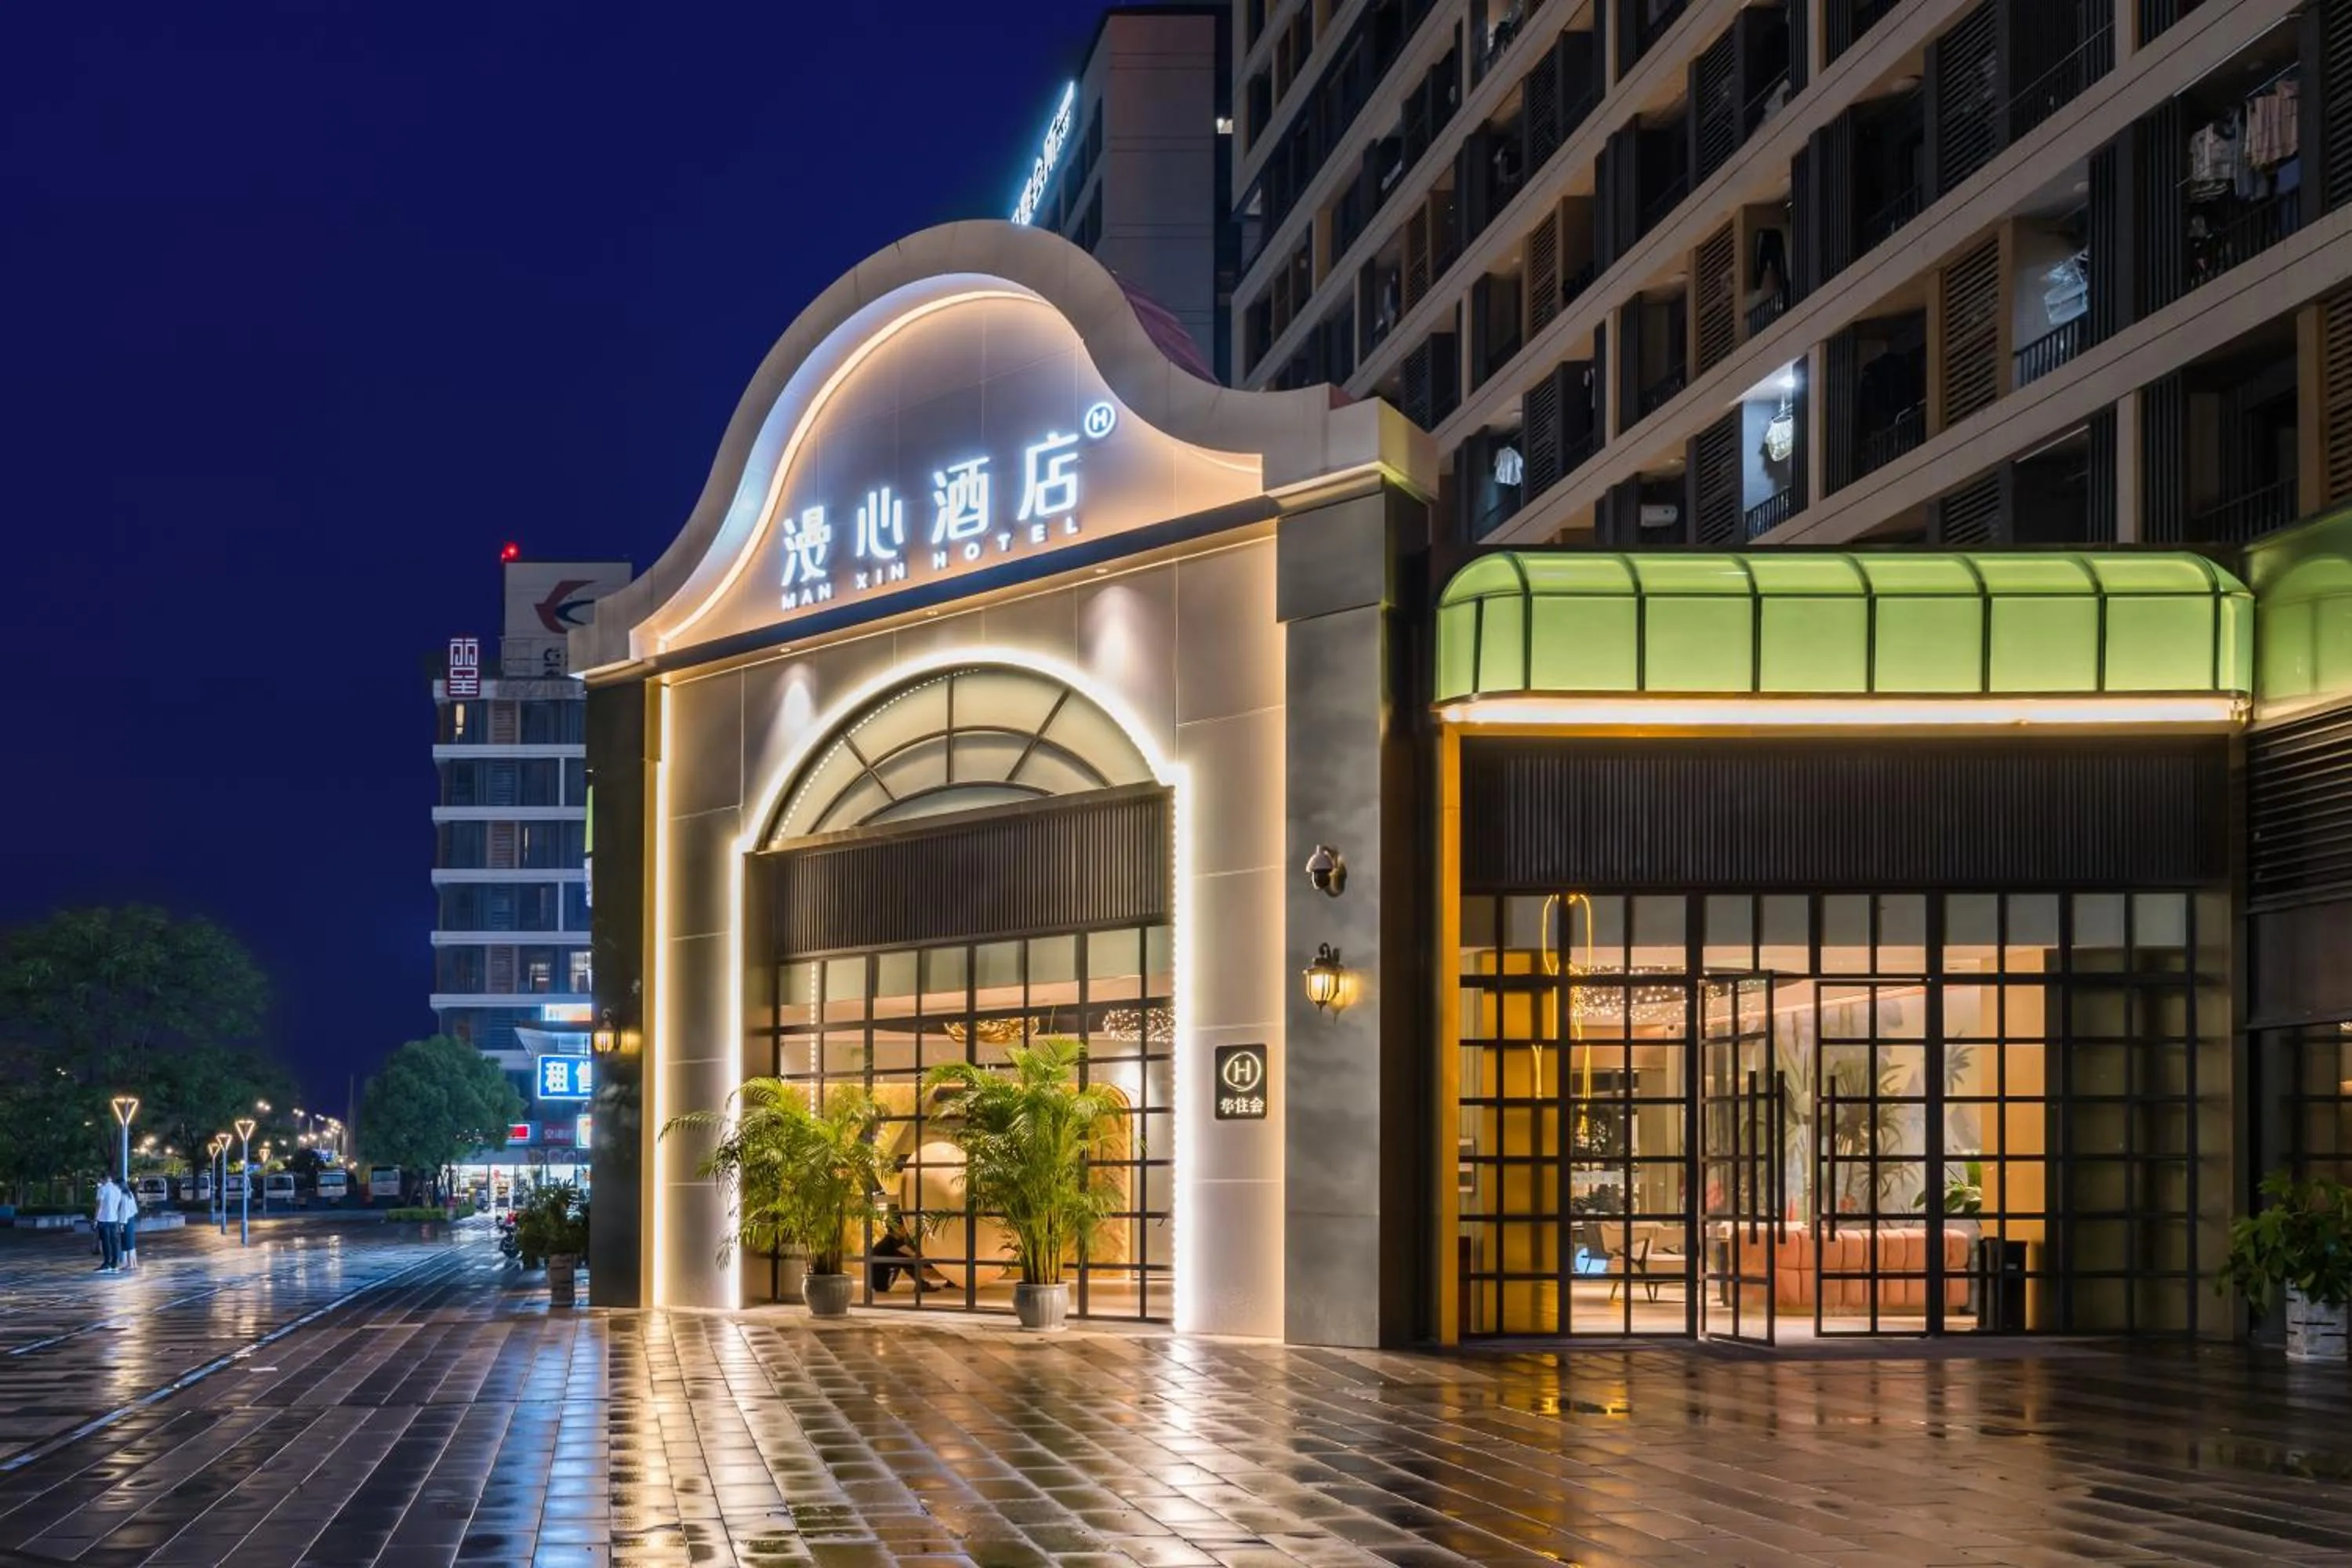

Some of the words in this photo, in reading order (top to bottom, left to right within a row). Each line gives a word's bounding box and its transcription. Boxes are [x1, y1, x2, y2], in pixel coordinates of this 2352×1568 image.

[781, 432, 1079, 586] 漫心酒店
[782, 583, 832, 610] MAN
[856, 562, 905, 590] XIN
[932, 517, 1079, 570] HOTEL
